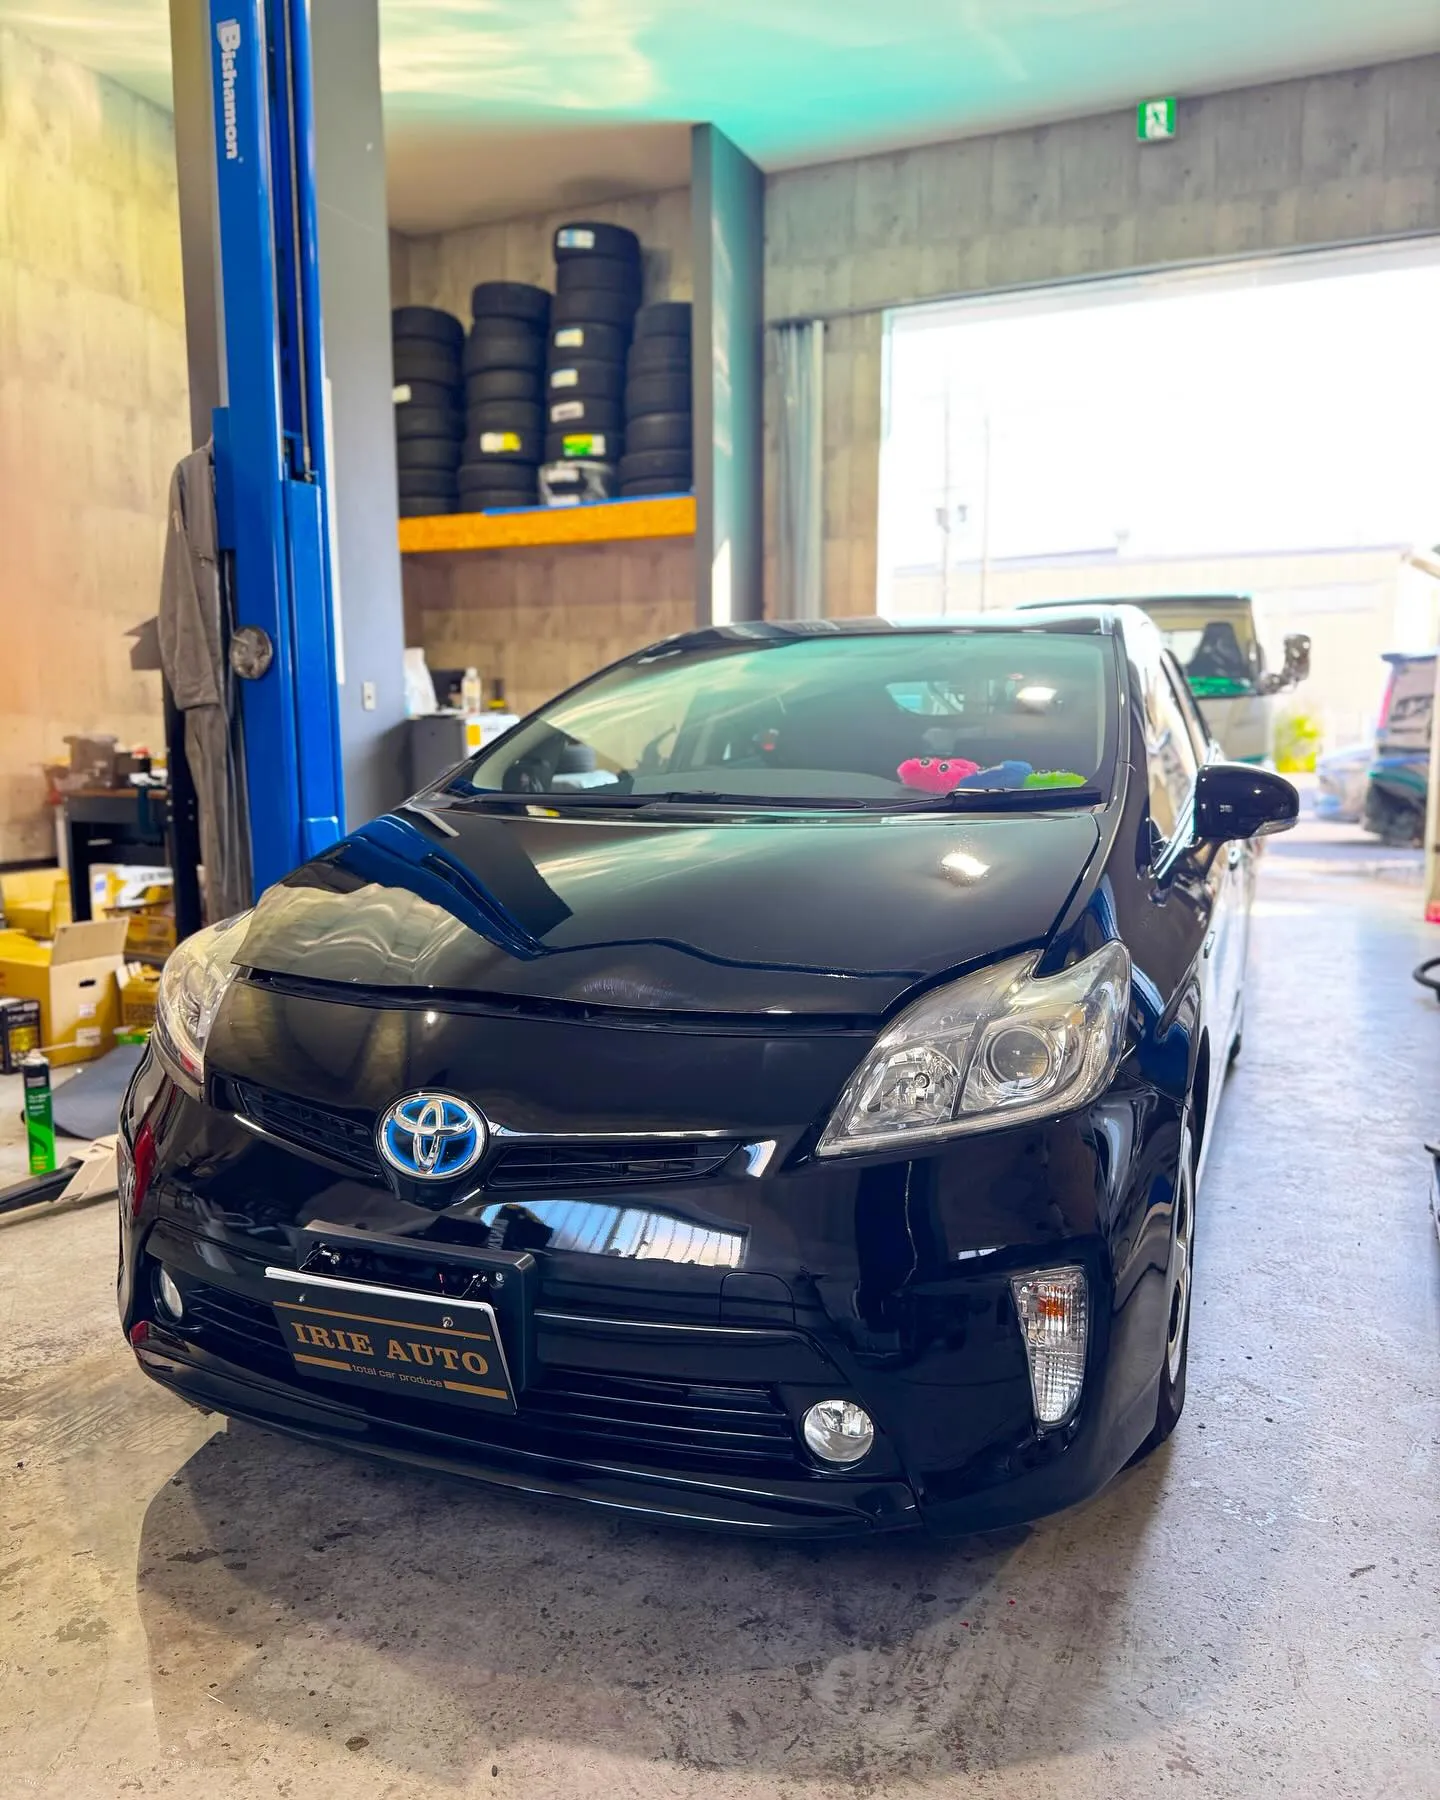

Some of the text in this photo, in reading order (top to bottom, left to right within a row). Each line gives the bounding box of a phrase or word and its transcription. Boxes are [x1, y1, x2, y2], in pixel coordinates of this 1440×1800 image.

[216, 18, 241, 160] Bishamon
[291, 1322, 489, 1375] IRIE AUTO
[352, 1364, 443, 1387] total car produce
